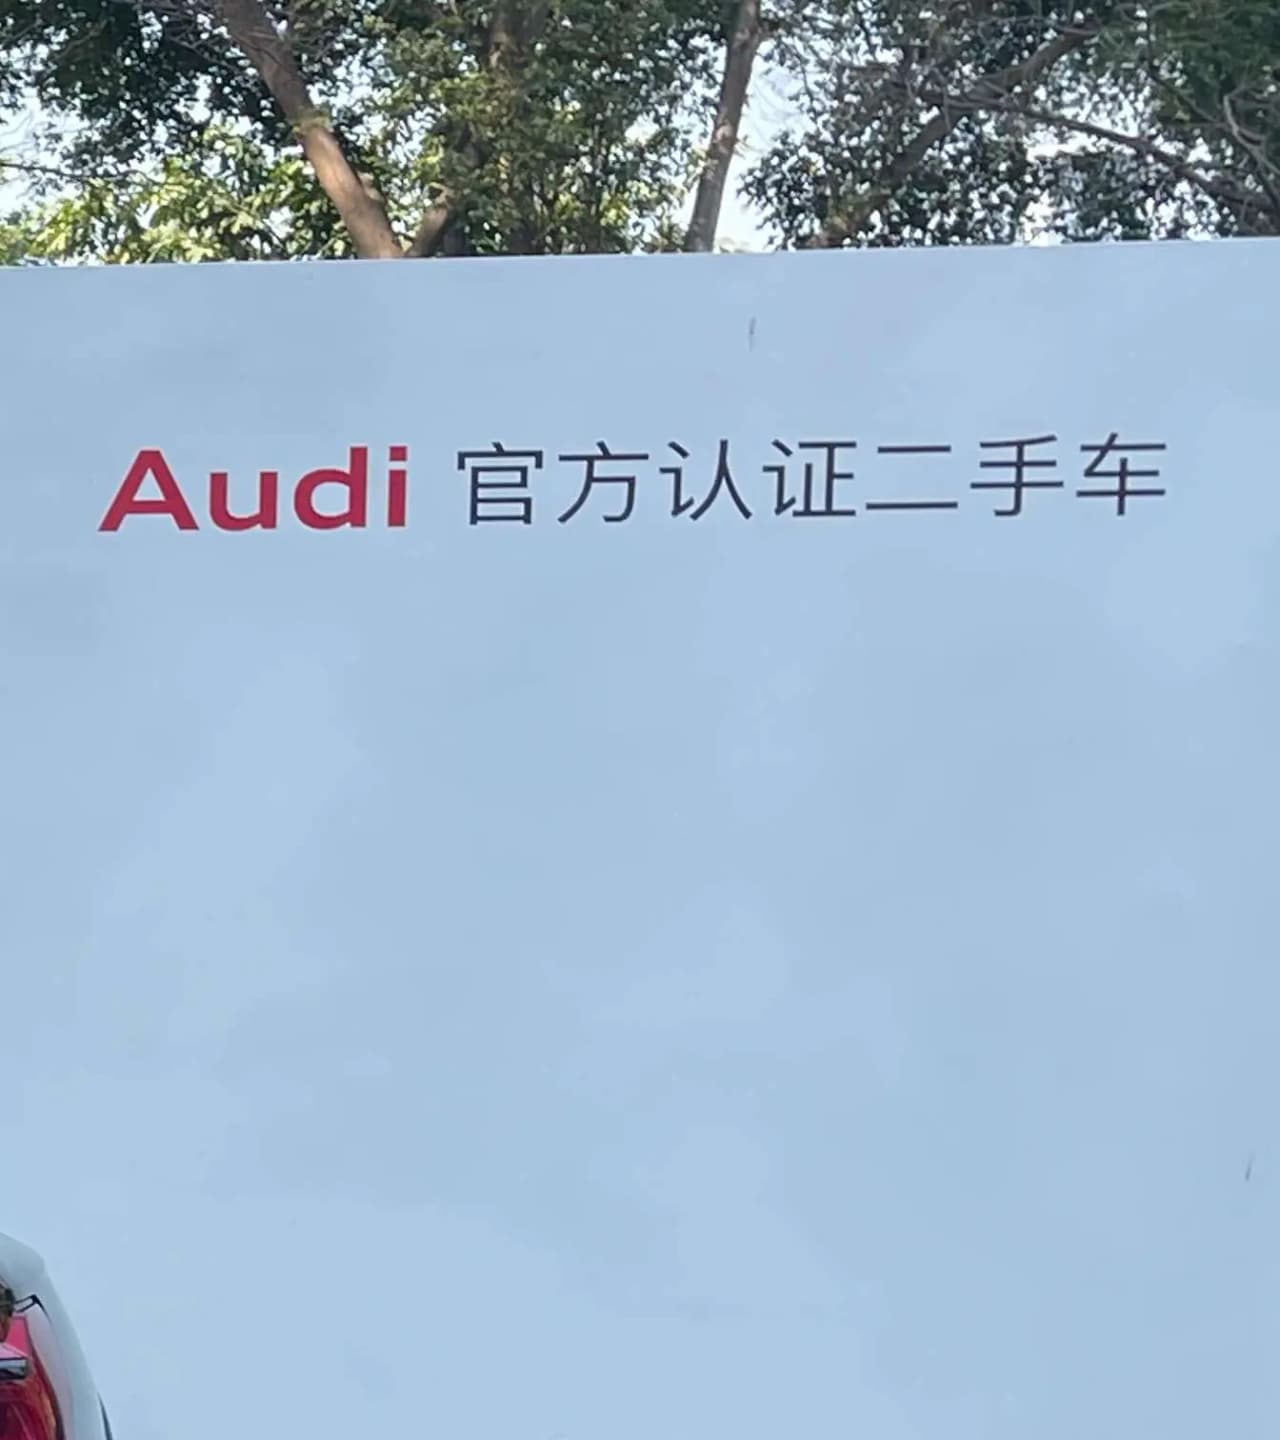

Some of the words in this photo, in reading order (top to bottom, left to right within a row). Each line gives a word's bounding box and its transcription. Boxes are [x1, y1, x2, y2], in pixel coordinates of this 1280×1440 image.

[97, 445, 408, 533] Audi
[454, 432, 1167, 526] 官方认证二手车
